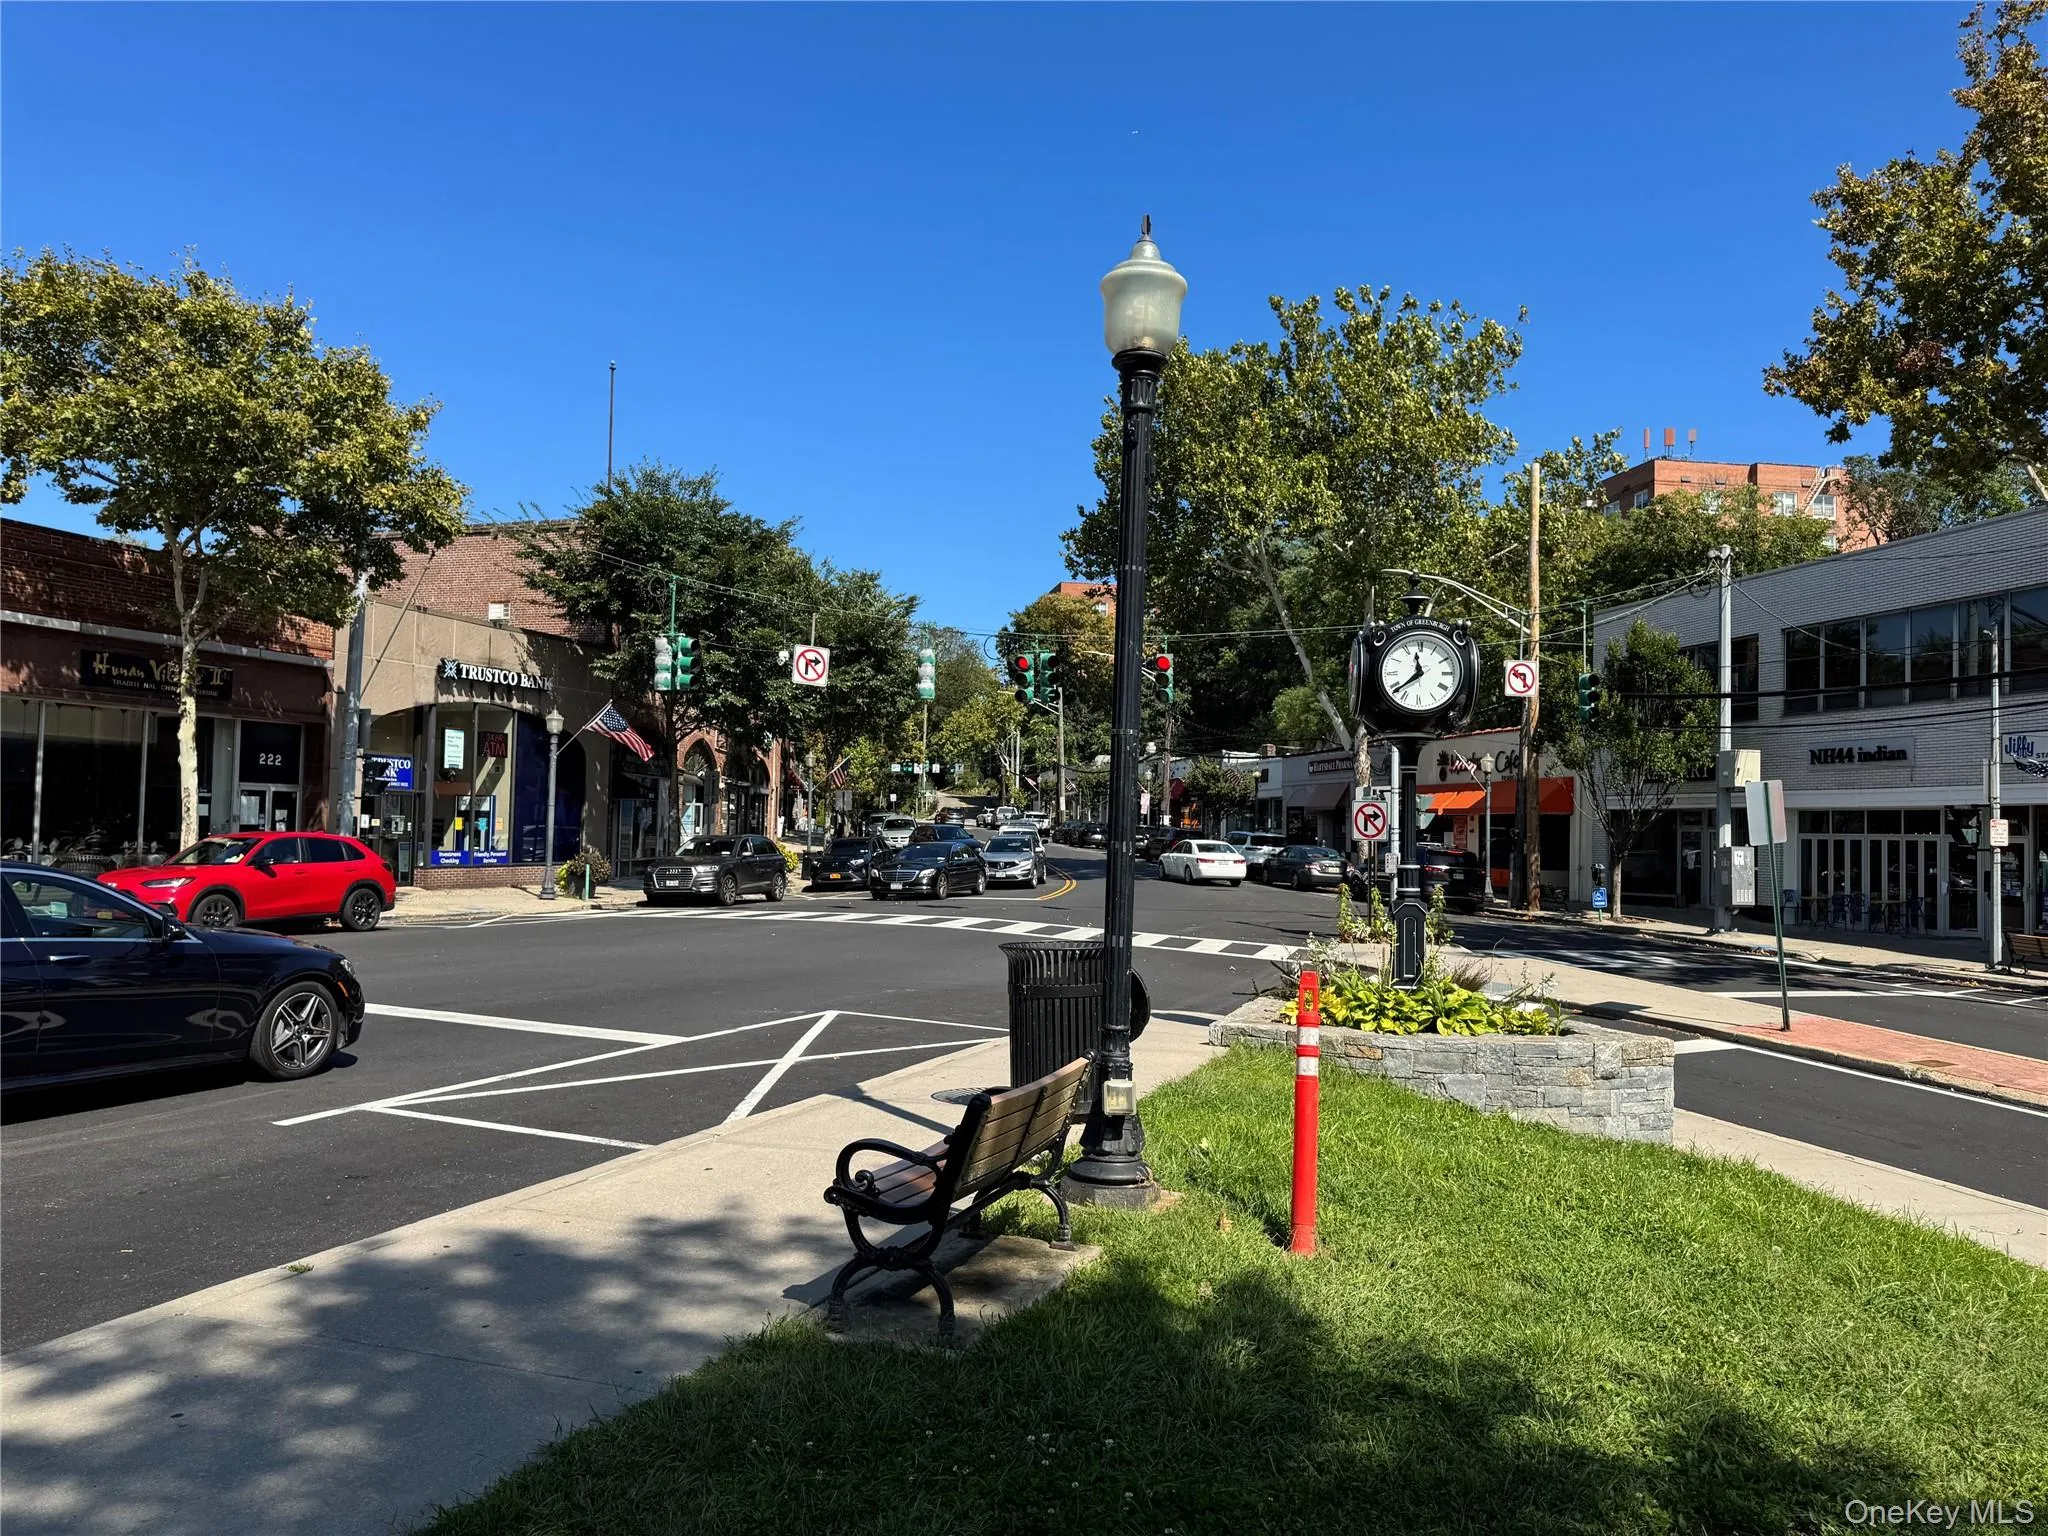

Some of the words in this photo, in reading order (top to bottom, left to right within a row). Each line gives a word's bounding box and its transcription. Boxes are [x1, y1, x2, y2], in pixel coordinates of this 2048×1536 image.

[1390, 622, 1406, 632] TOWN
[92, 653, 145, 679] Hunan
[112, 678, 157, 691] TRADITINAL
[460, 664, 518, 686] TRUSTCO
[520, 673, 554, 691] BANK
[484, 741, 506, 757] ATM
[1809, 747, 1855, 765] NH44
[1857, 745, 1908, 762] indian
[2005, 735, 2034, 759] Jiffy
[259, 753, 282, 766] 222
